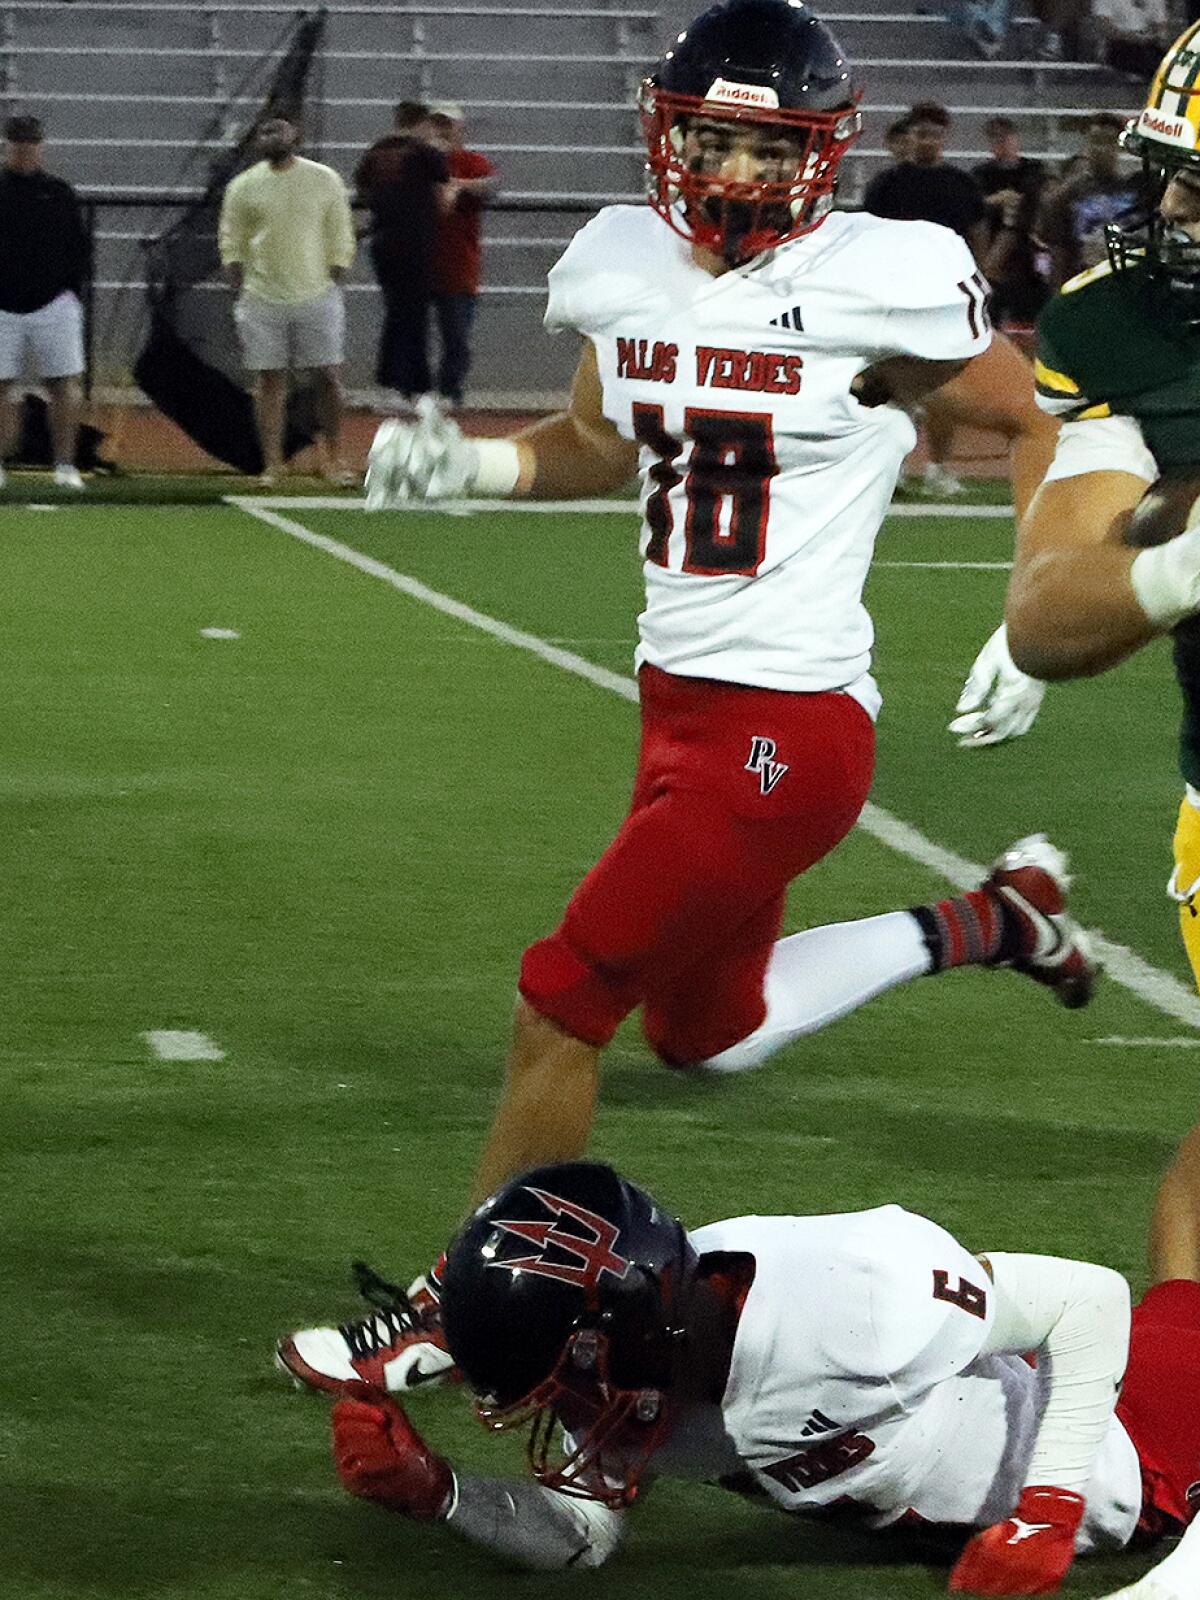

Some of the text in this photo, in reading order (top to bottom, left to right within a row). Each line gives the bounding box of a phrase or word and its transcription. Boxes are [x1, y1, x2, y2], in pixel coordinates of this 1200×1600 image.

[695, 345, 804, 396] VERDES
[631, 400, 781, 578] 18
[743, 735, 789, 796] PV
